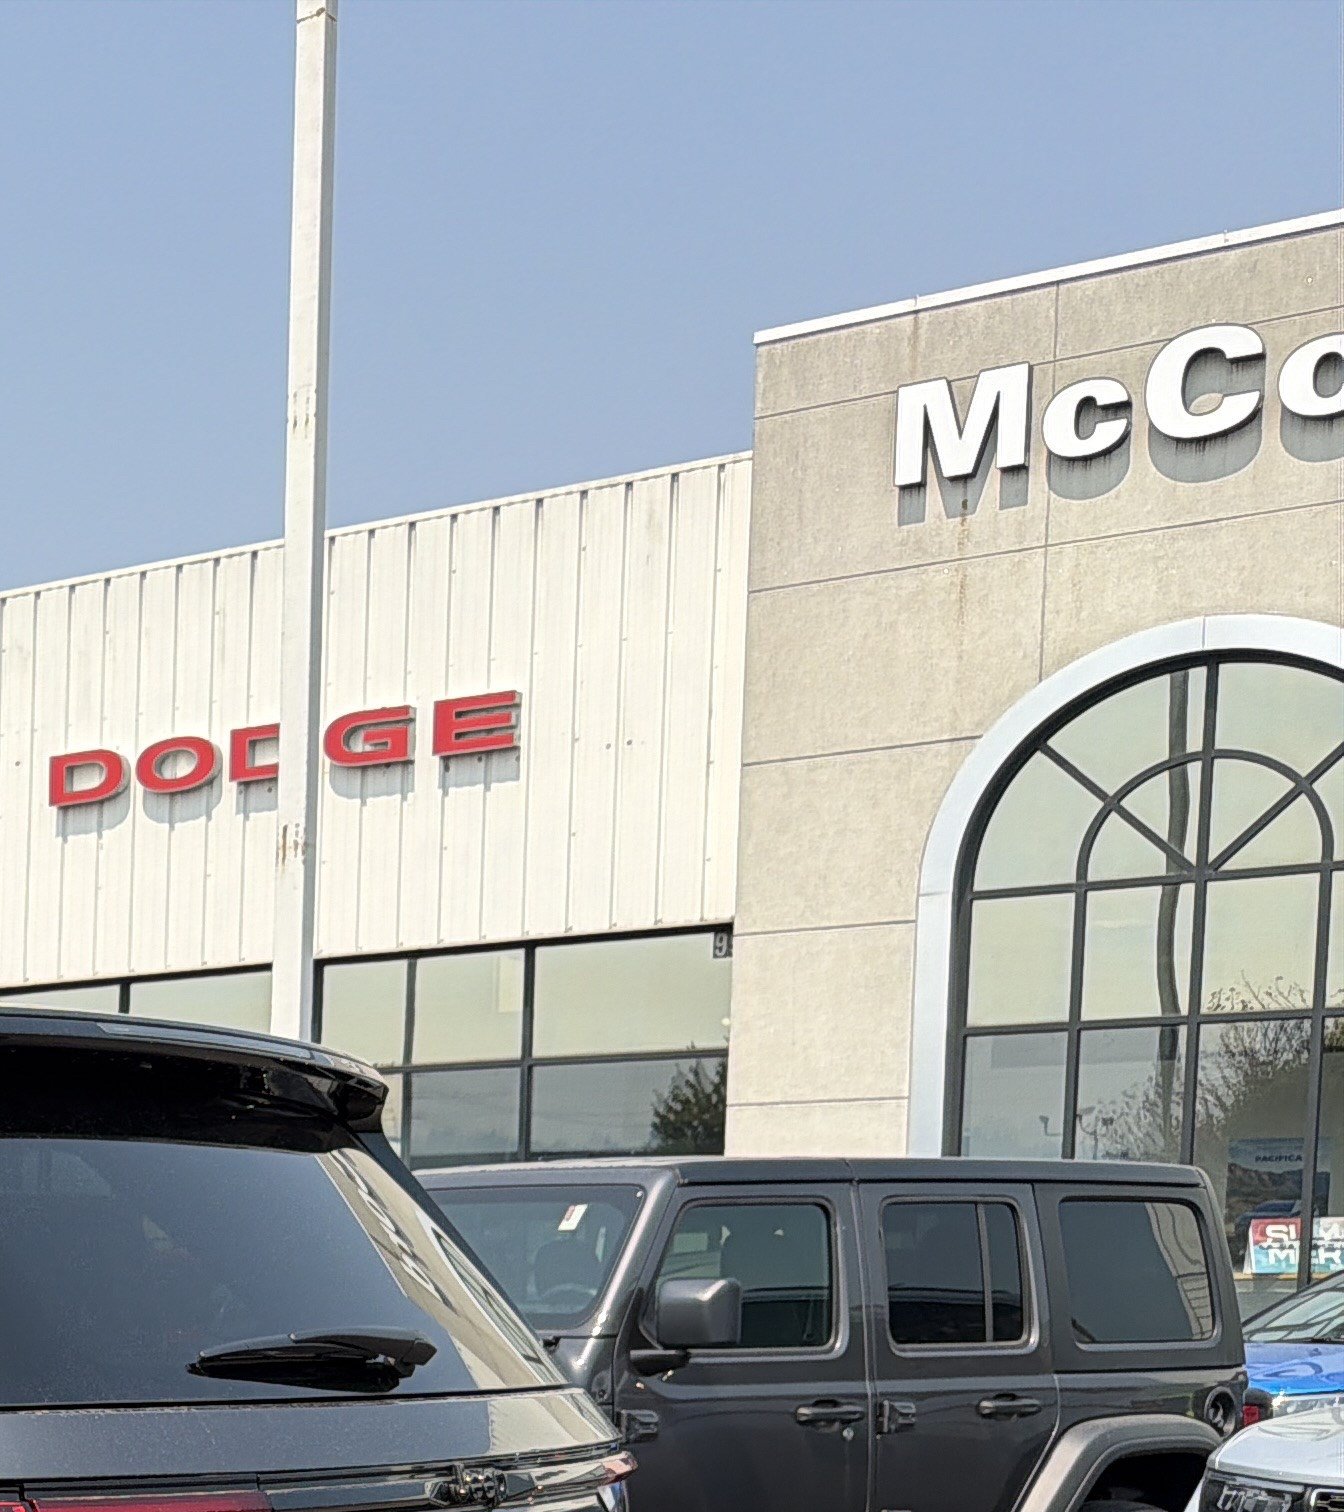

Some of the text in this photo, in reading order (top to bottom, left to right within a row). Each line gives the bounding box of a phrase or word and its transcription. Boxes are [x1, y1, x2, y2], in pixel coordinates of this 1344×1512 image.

[894, 323, 1344, 487] McCo
[715, 932, 728, 957] 9
[1255, 1154, 1303, 1162] PACIFICA
